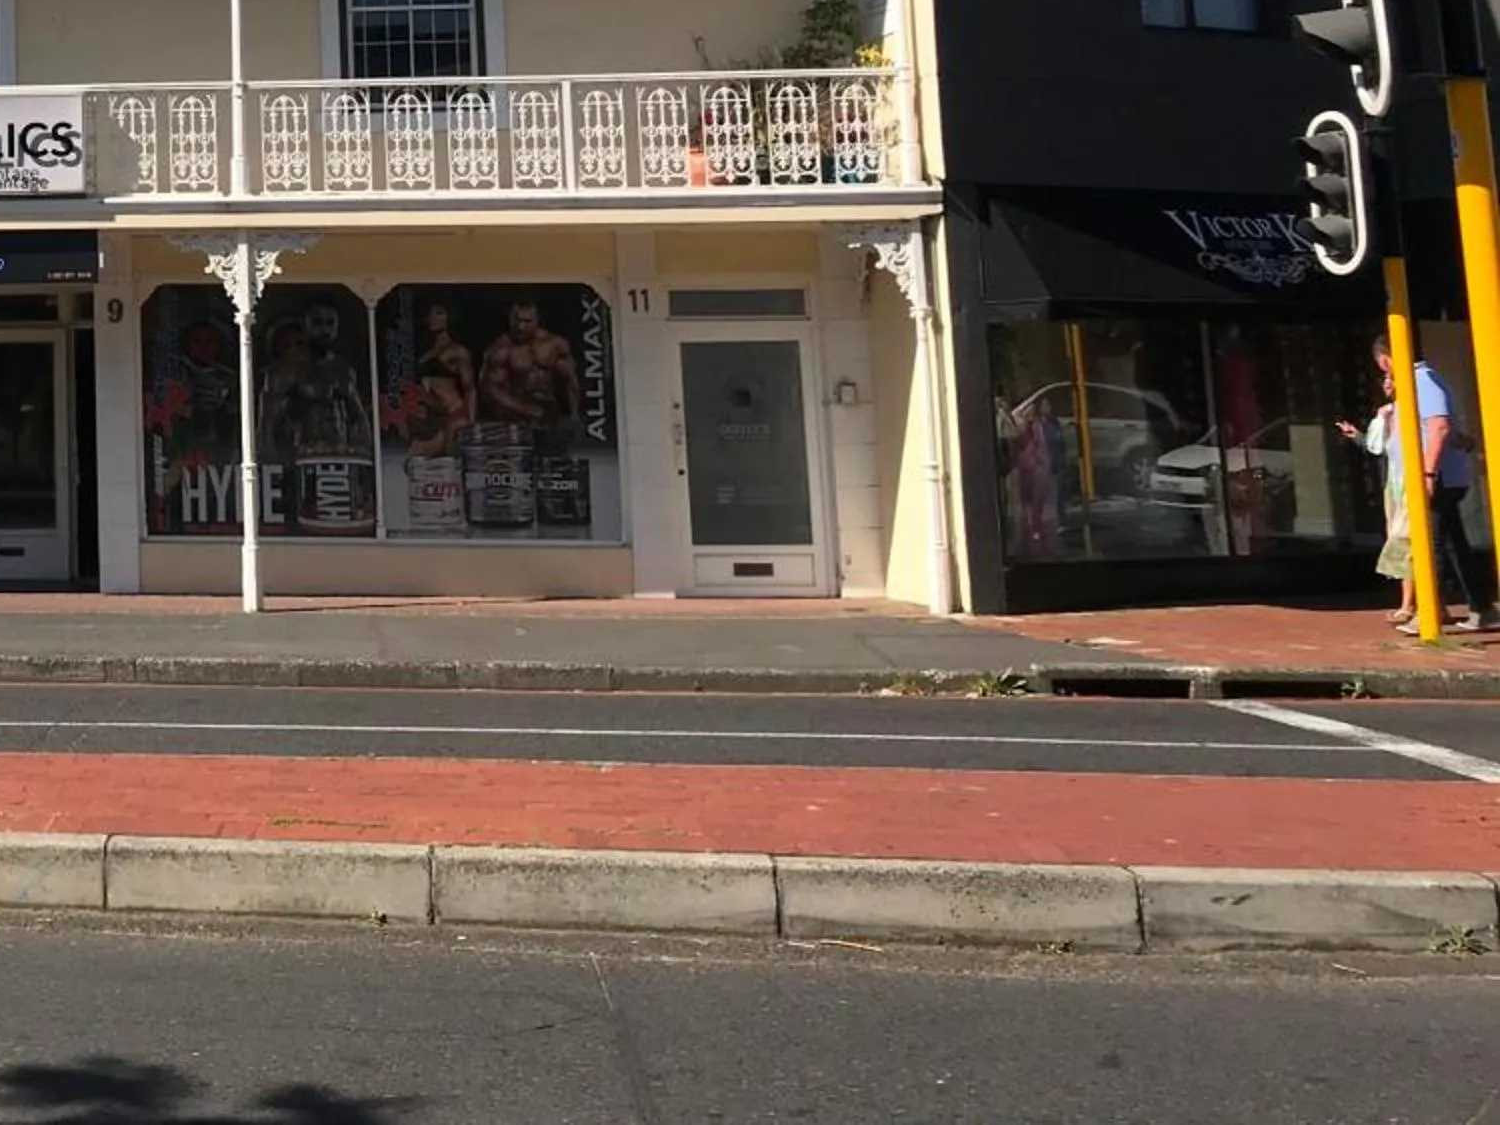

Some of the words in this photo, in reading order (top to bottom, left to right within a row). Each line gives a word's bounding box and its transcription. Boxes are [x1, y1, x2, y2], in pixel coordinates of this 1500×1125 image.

[107, 299, 123, 323] 9
[627, 288, 650, 313] 11
[580, 297, 607, 442] ALLMAX
[182, 463, 286, 523] HYE
[316, 464, 351, 522] HYDE
